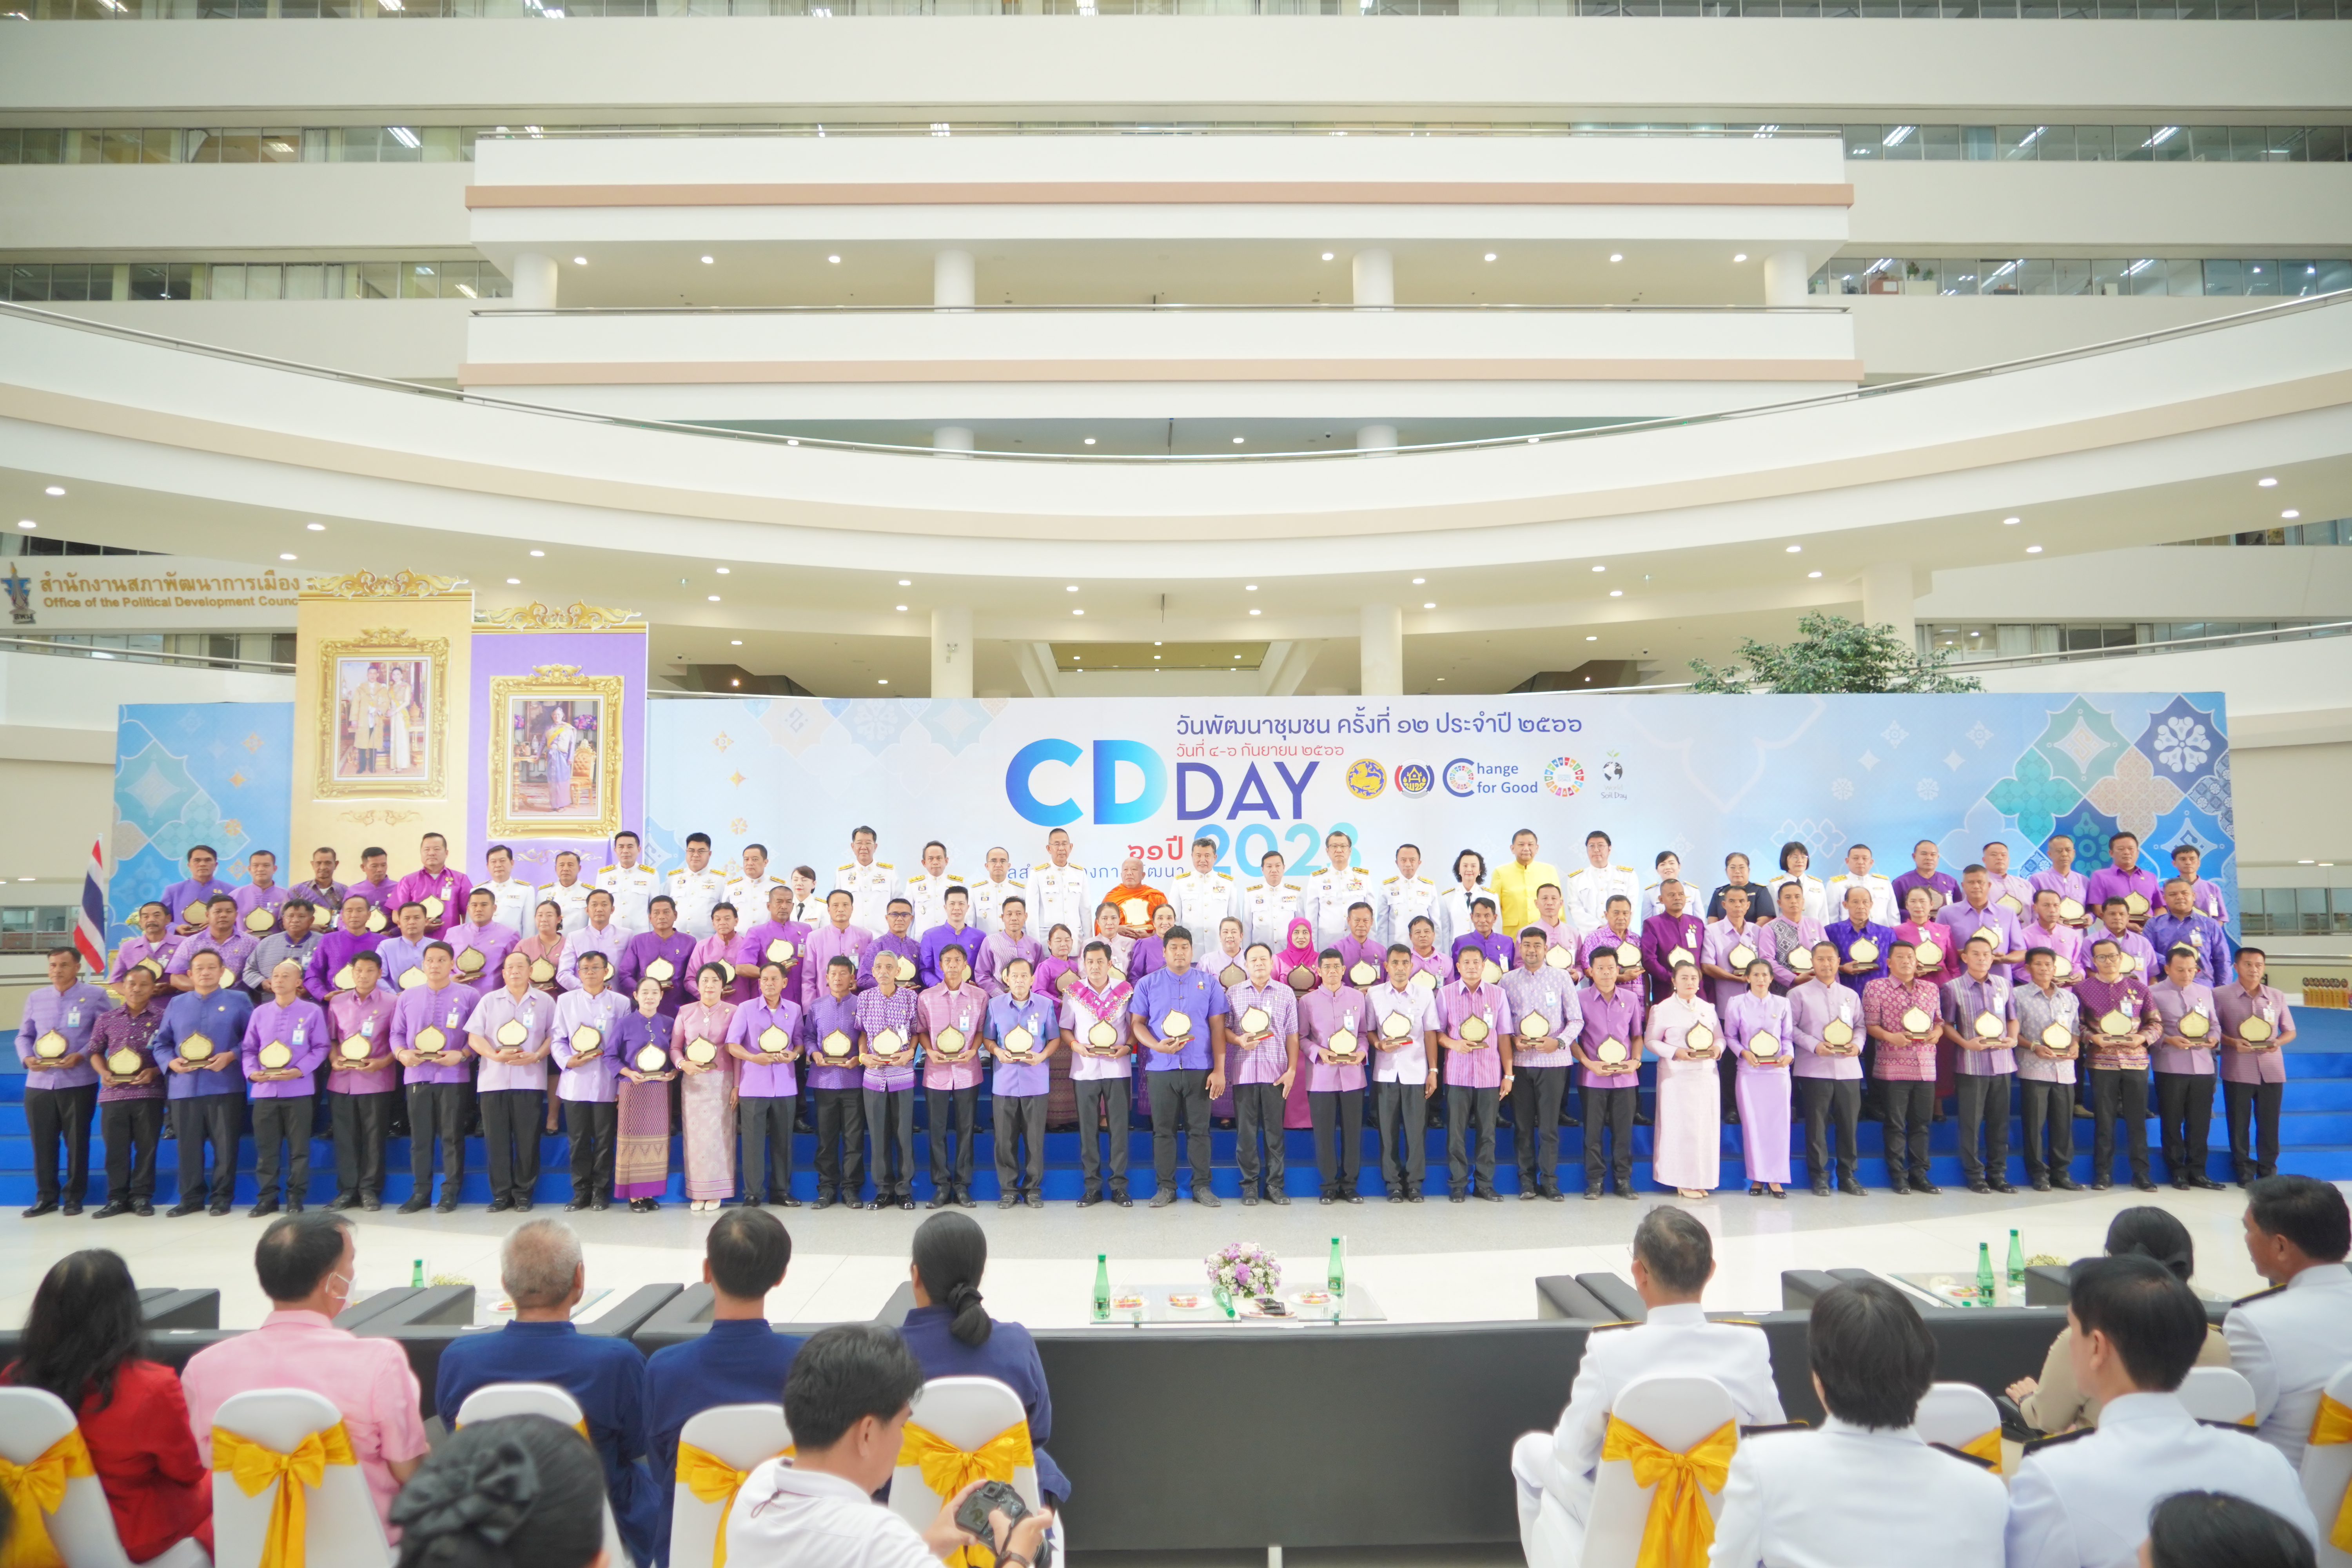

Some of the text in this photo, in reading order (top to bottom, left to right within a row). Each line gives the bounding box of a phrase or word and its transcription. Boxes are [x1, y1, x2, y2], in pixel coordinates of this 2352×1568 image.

[40, 569, 299, 592] สำนักงานสภาพัฒนาการเมือง
[44, 595, 298, 608] Office of the Political Development Counc
[1177, 707, 1582, 740] วันพัฒนาชุมชน ครั้งที่ ๑๒ ประจำปี ๒๕๖๖
[1177, 739, 1344, 757] วันที่ ๔-๖ กันยายน ๒๕๖๖
[1005, 739, 1319, 827] CD DAY
[1477, 781, 1538, 793] for Good
[1614, 792, 1627, 800] Day
[1128, 835, 1183, 860] ๖๑ปี
